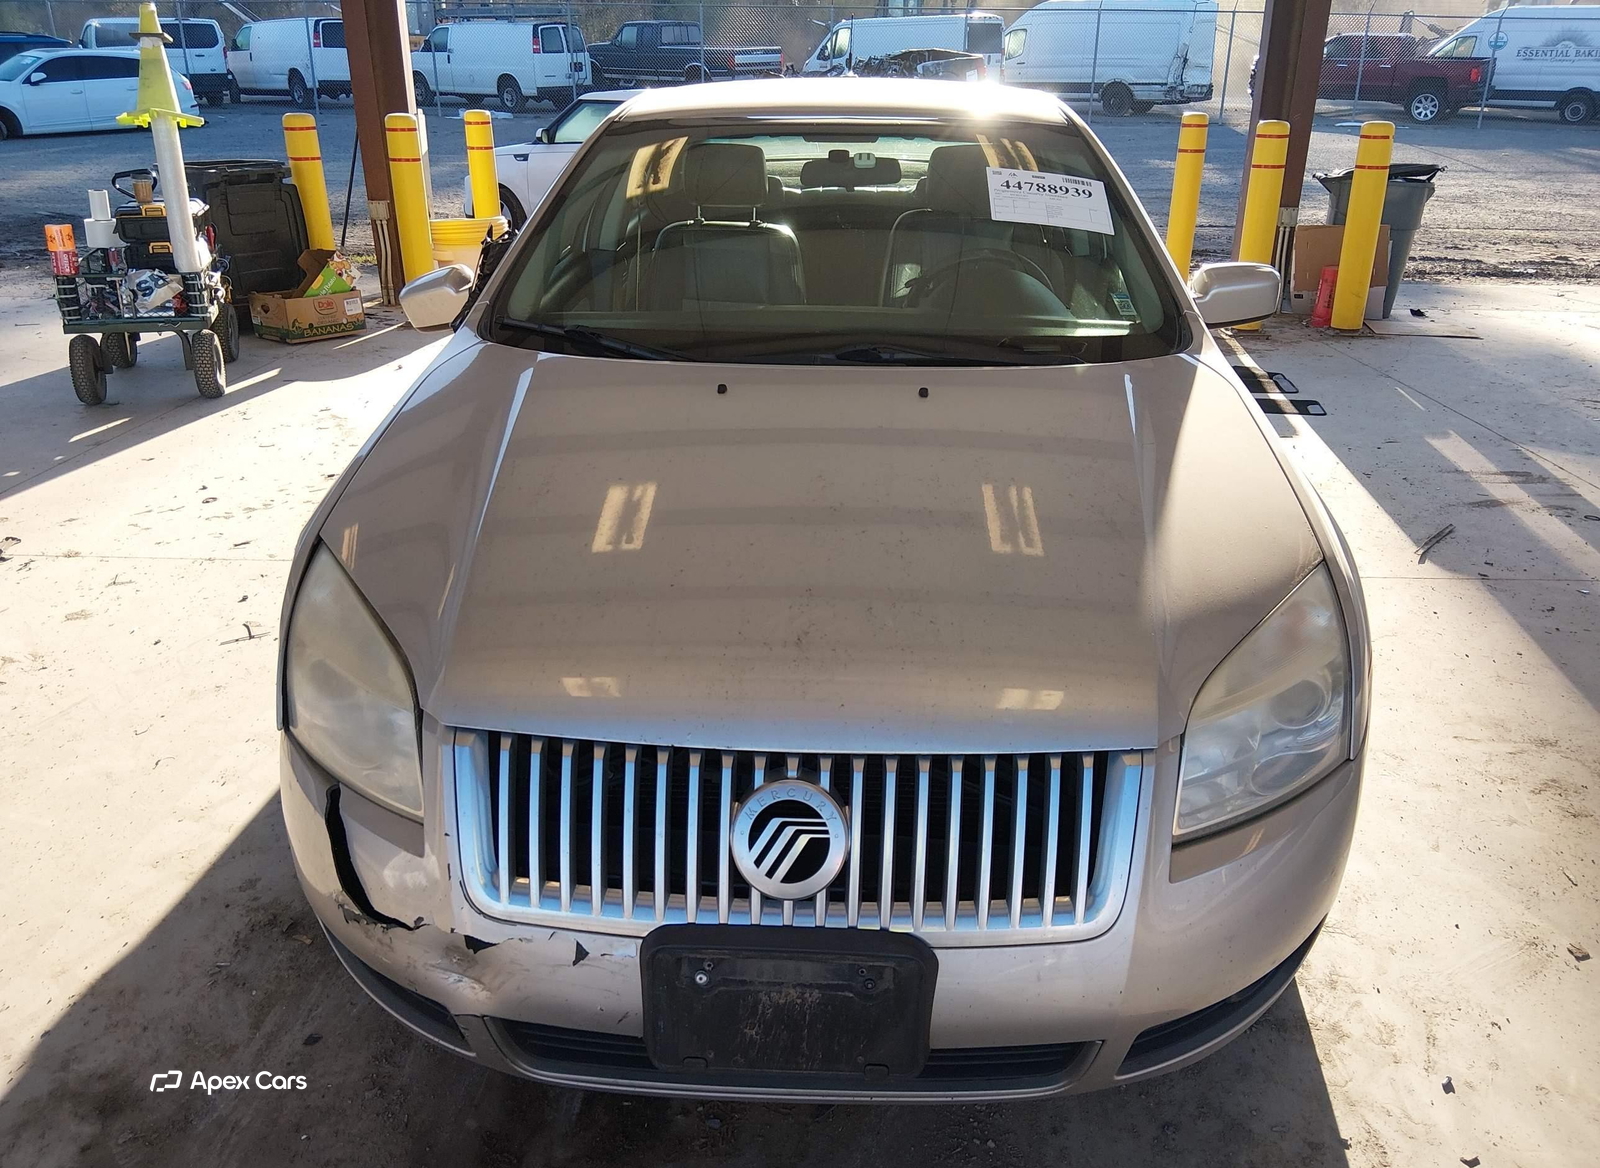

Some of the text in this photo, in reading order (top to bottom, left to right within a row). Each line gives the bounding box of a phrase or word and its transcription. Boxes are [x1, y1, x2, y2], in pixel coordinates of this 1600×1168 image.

[1516, 49, 1600, 58] ESSENTIAL BAKI
[1000, 179, 1093, 199] 44788939
[318, 300, 334, 309] Dole
[304, 322, 354, 337] BANANAS
[744, 787, 838, 821] MERCURY
